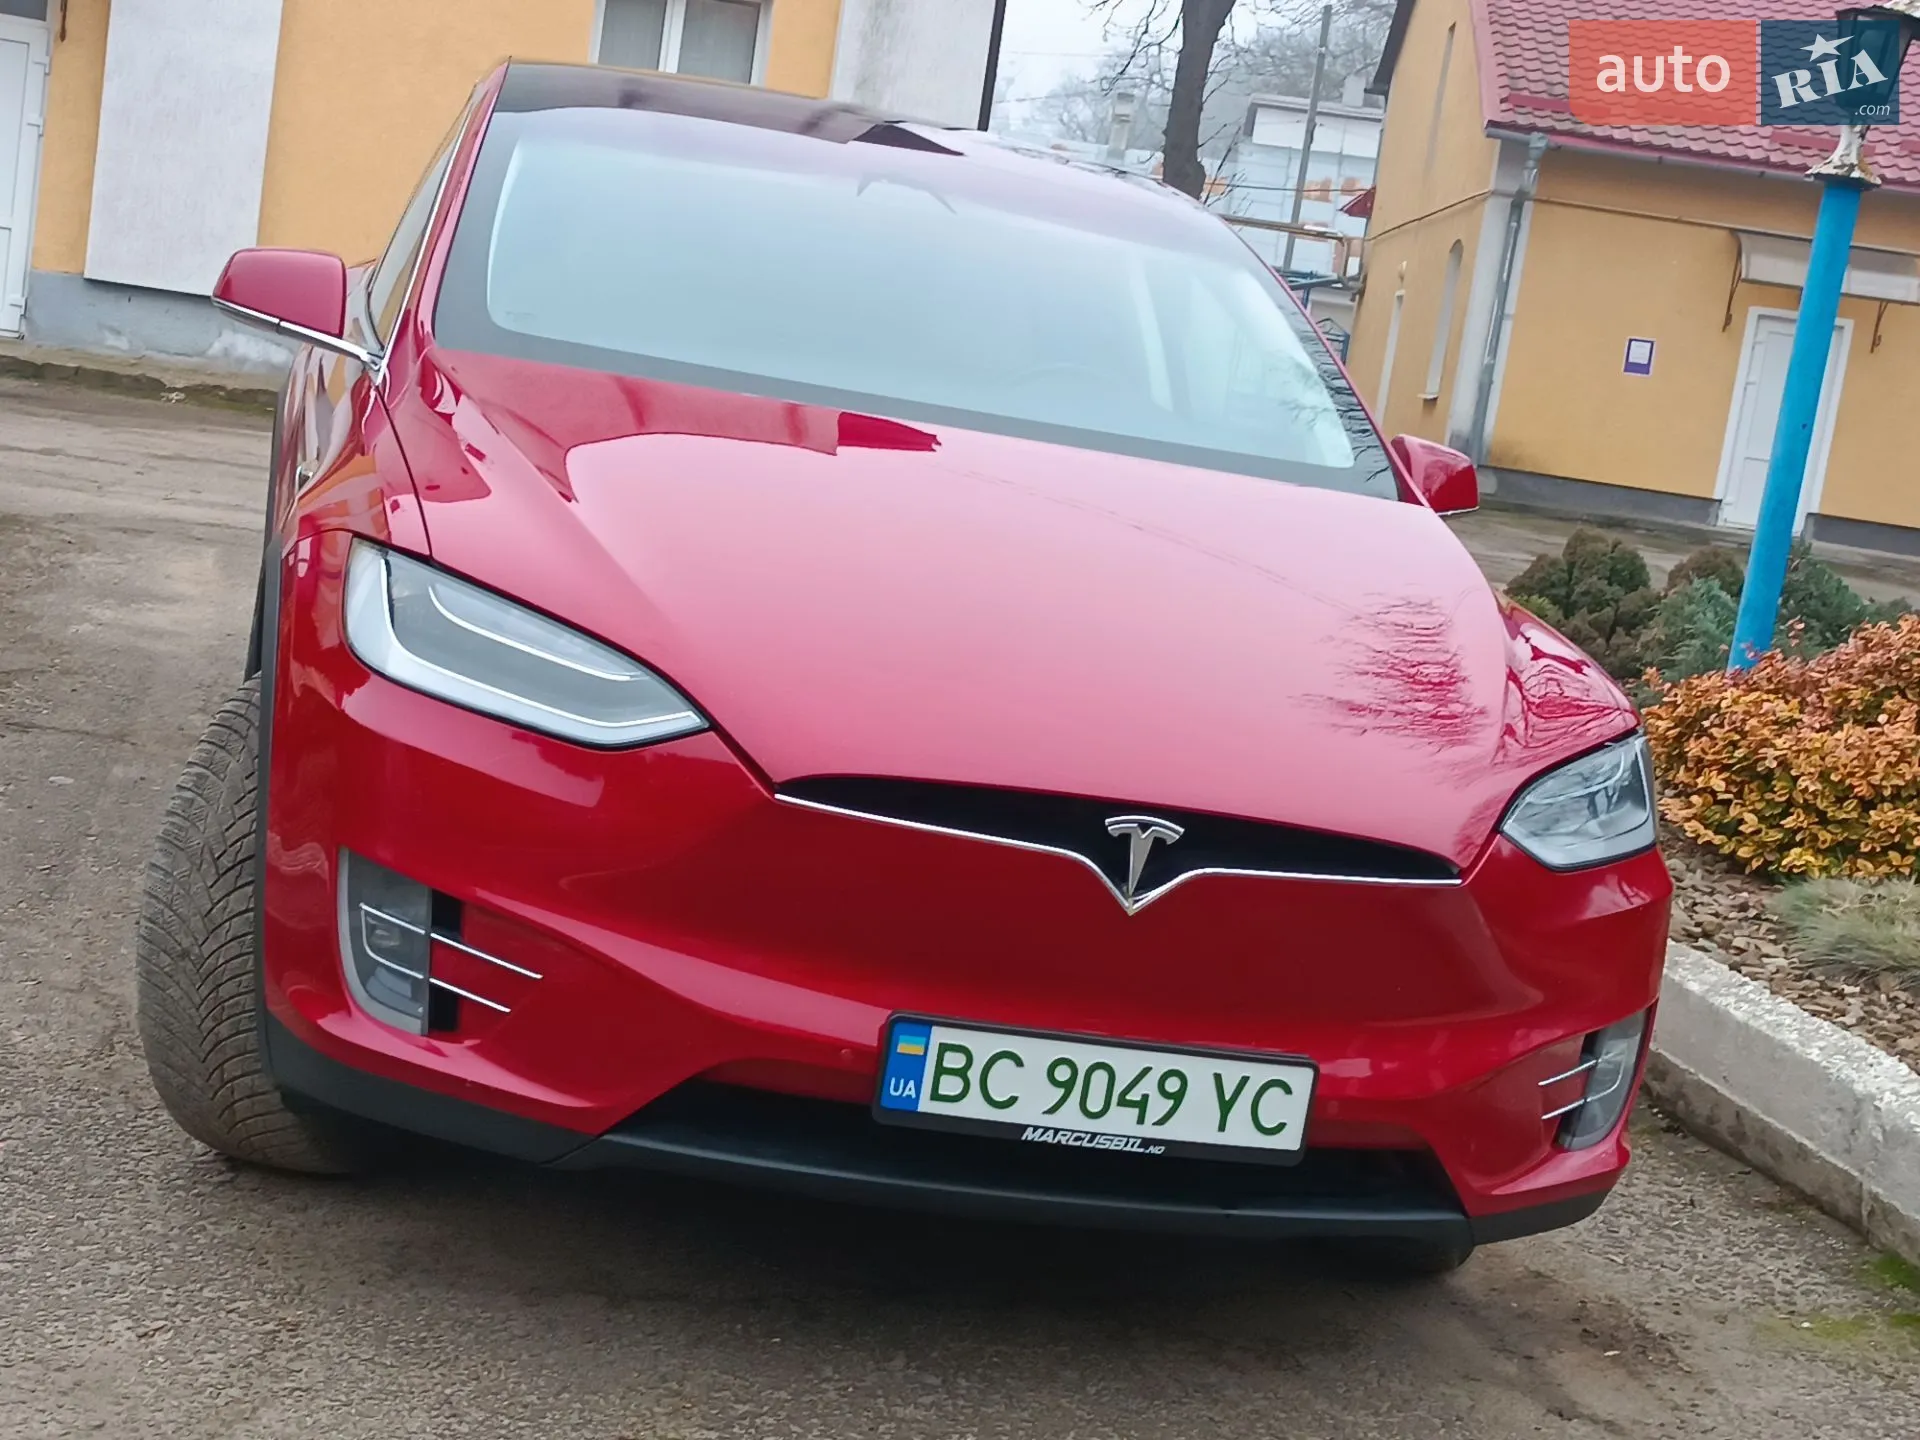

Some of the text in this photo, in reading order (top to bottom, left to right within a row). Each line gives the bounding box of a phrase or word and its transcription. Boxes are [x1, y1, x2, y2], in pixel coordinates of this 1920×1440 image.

[889, 1077, 916, 1099] UA
[930, 1042, 1293, 1136] BC 9049 YC
